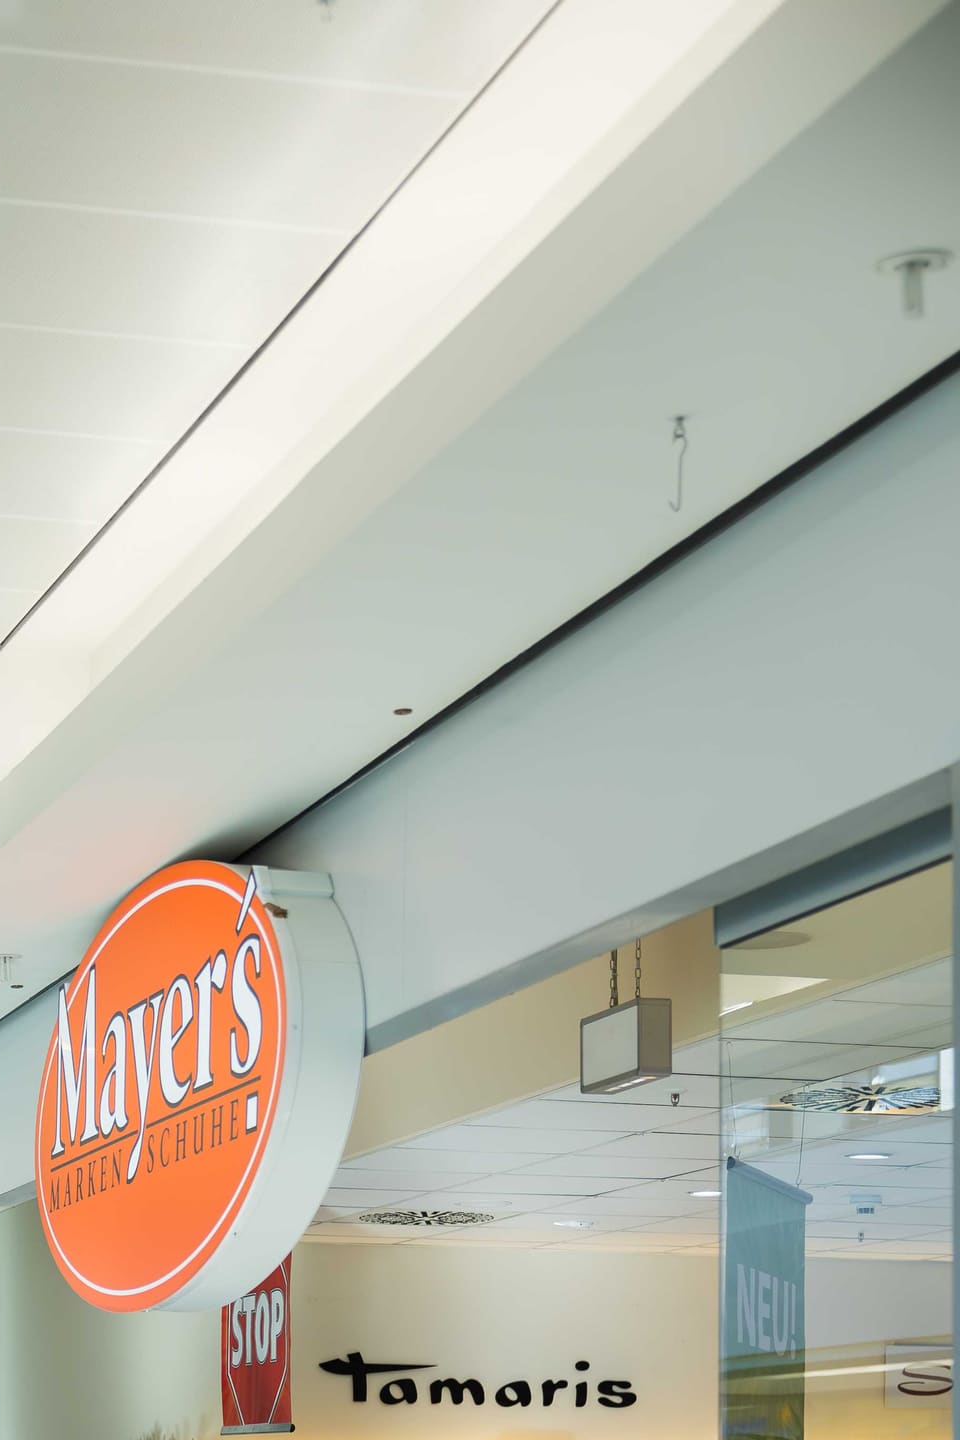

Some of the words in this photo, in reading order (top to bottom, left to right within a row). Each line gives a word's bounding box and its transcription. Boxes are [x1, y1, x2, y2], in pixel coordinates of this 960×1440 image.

[49, 1149, 122, 1213] MARKEN
[146, 1099, 239, 1173] SCHUHE
[231, 1287, 285, 1368] STOP
[737, 1264, 797, 1360] NEU!
